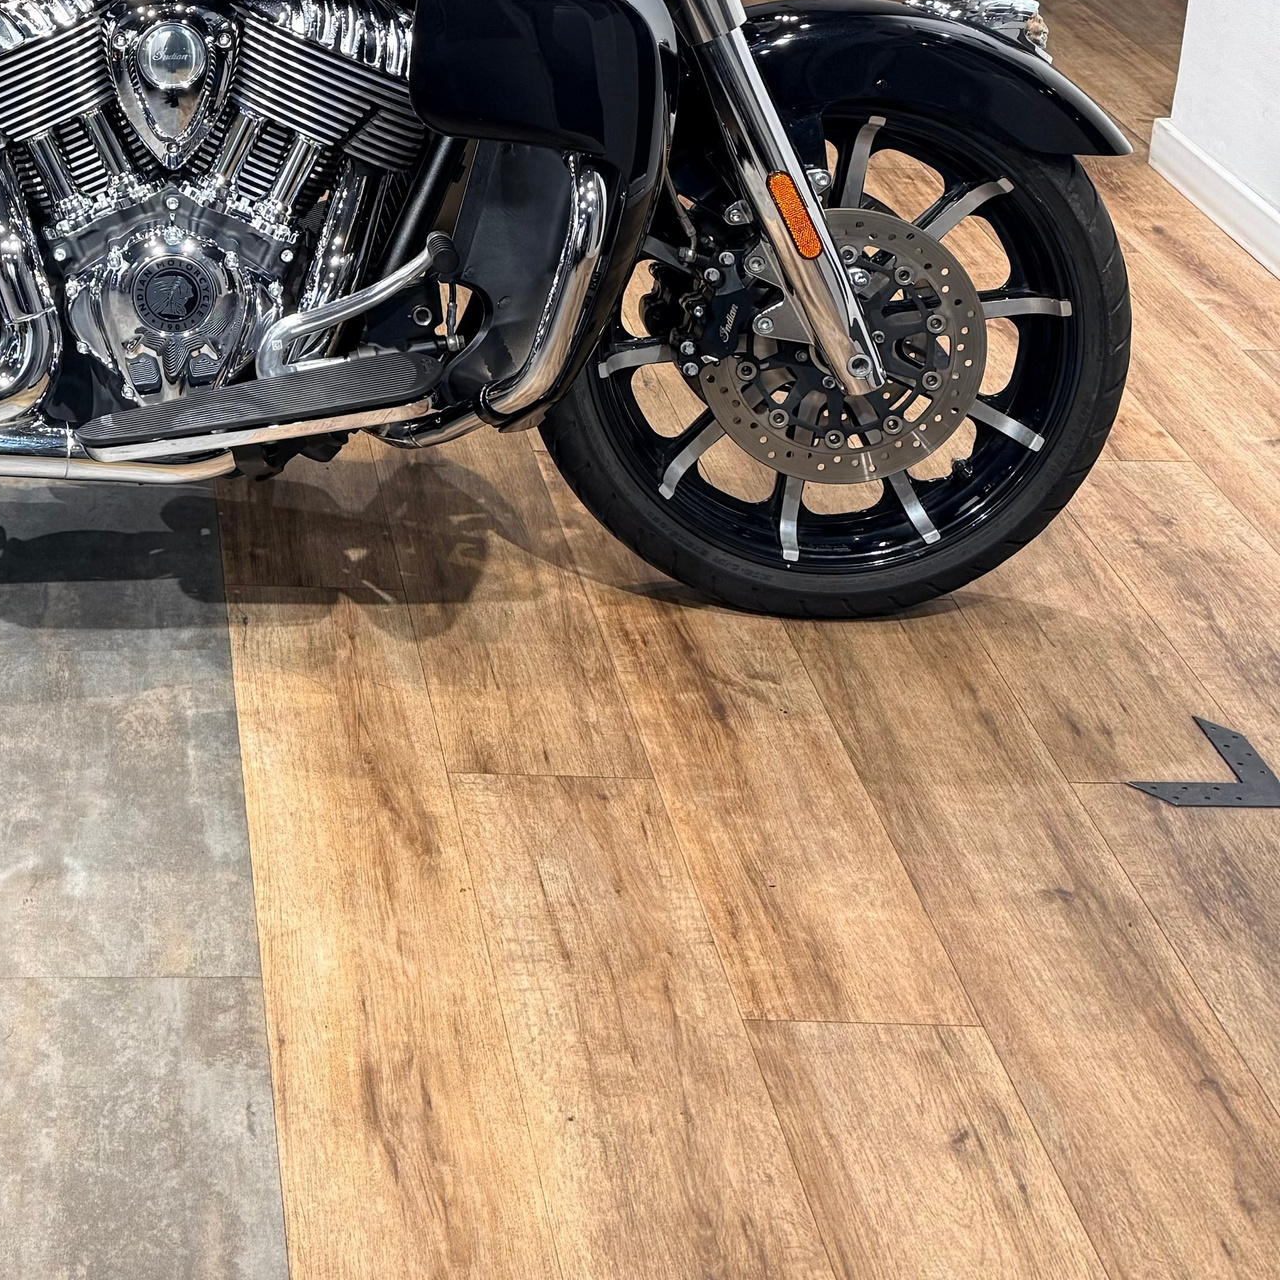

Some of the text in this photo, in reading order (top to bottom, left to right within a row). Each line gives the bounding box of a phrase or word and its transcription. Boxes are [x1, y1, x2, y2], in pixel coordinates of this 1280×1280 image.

[152, 46, 189, 61] Indian
[136, 259, 210, 317] INDIAN MOTORCYCLE
[160, 322, 188, 331] 1901
[719, 303, 739, 343] Indian
